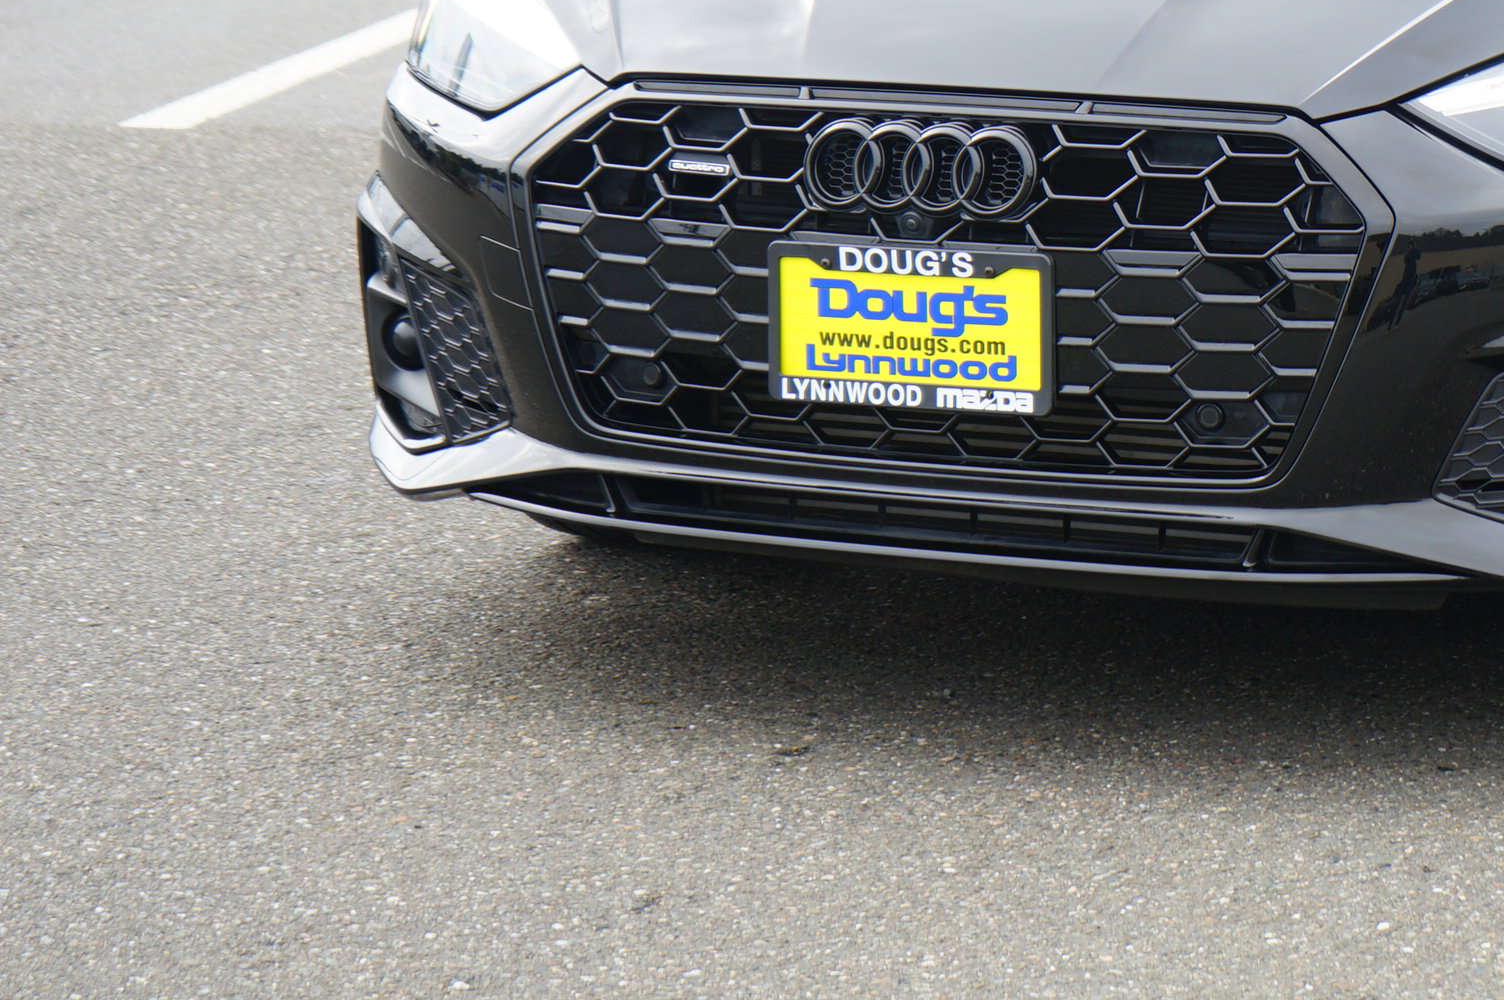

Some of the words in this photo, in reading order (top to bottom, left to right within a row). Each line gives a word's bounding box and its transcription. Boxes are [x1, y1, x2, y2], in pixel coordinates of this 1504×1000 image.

[671, 162, 725, 173] quattro
[838, 246, 974, 278] DOUG'S
[819, 331, 1006, 356] www.dougs.com
[806, 343, 1017, 382] Lynnwood
[781, 377, 922, 407] LYNNWOOD
